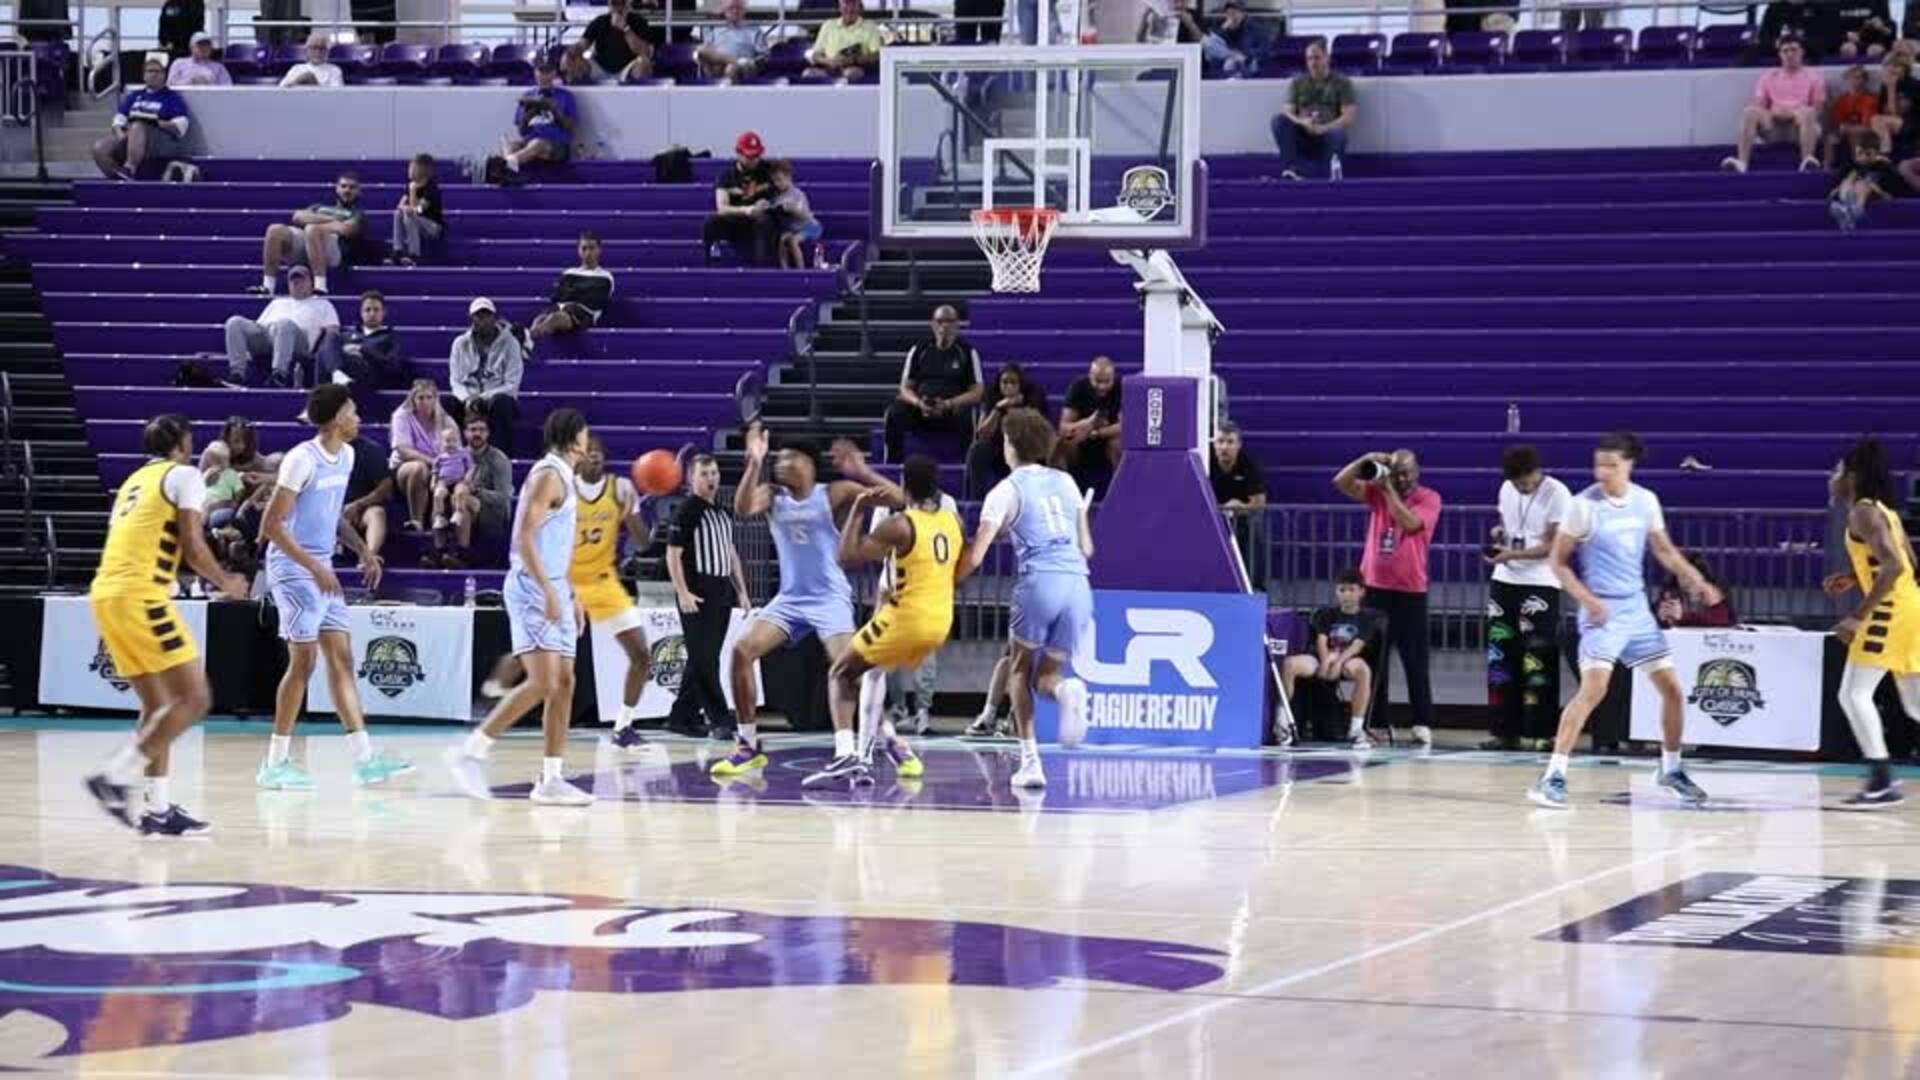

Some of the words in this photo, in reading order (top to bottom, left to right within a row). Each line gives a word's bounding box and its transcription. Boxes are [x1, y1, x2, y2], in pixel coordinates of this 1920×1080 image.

[1039, 495, 1068, 535] 11
[933, 532, 949, 564] 0
[1085, 692, 1219, 731] EAGUEREADY
